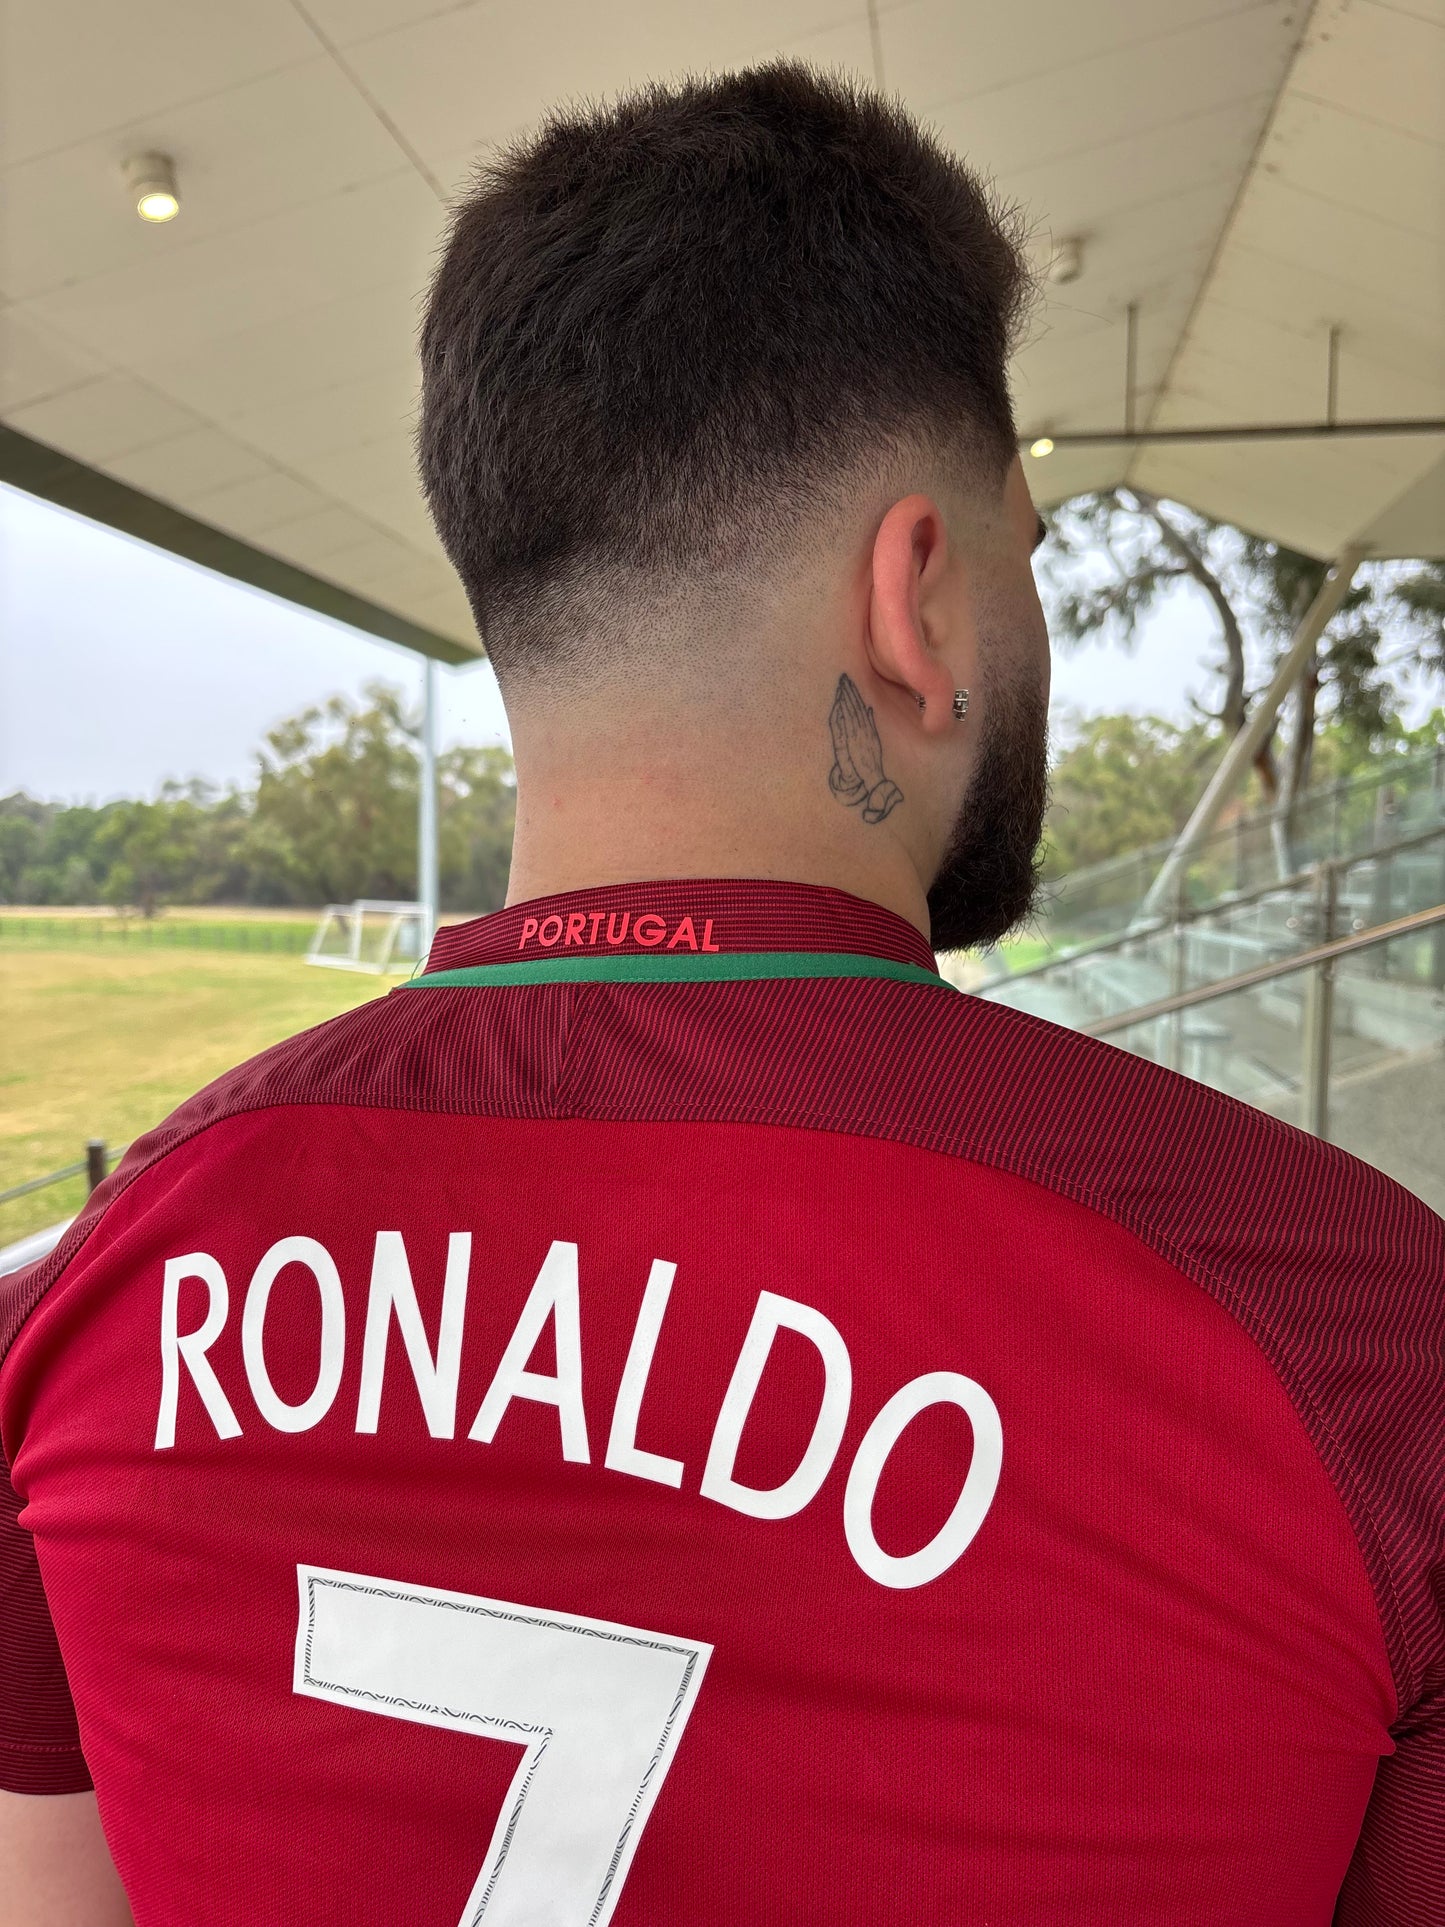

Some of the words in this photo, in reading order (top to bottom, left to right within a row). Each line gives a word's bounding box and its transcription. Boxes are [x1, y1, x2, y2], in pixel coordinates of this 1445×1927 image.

[518, 912, 720, 952] PORTUGAL
[154, 1230, 1004, 1589] RONALDO
[292, 1563, 715, 1927] 7
